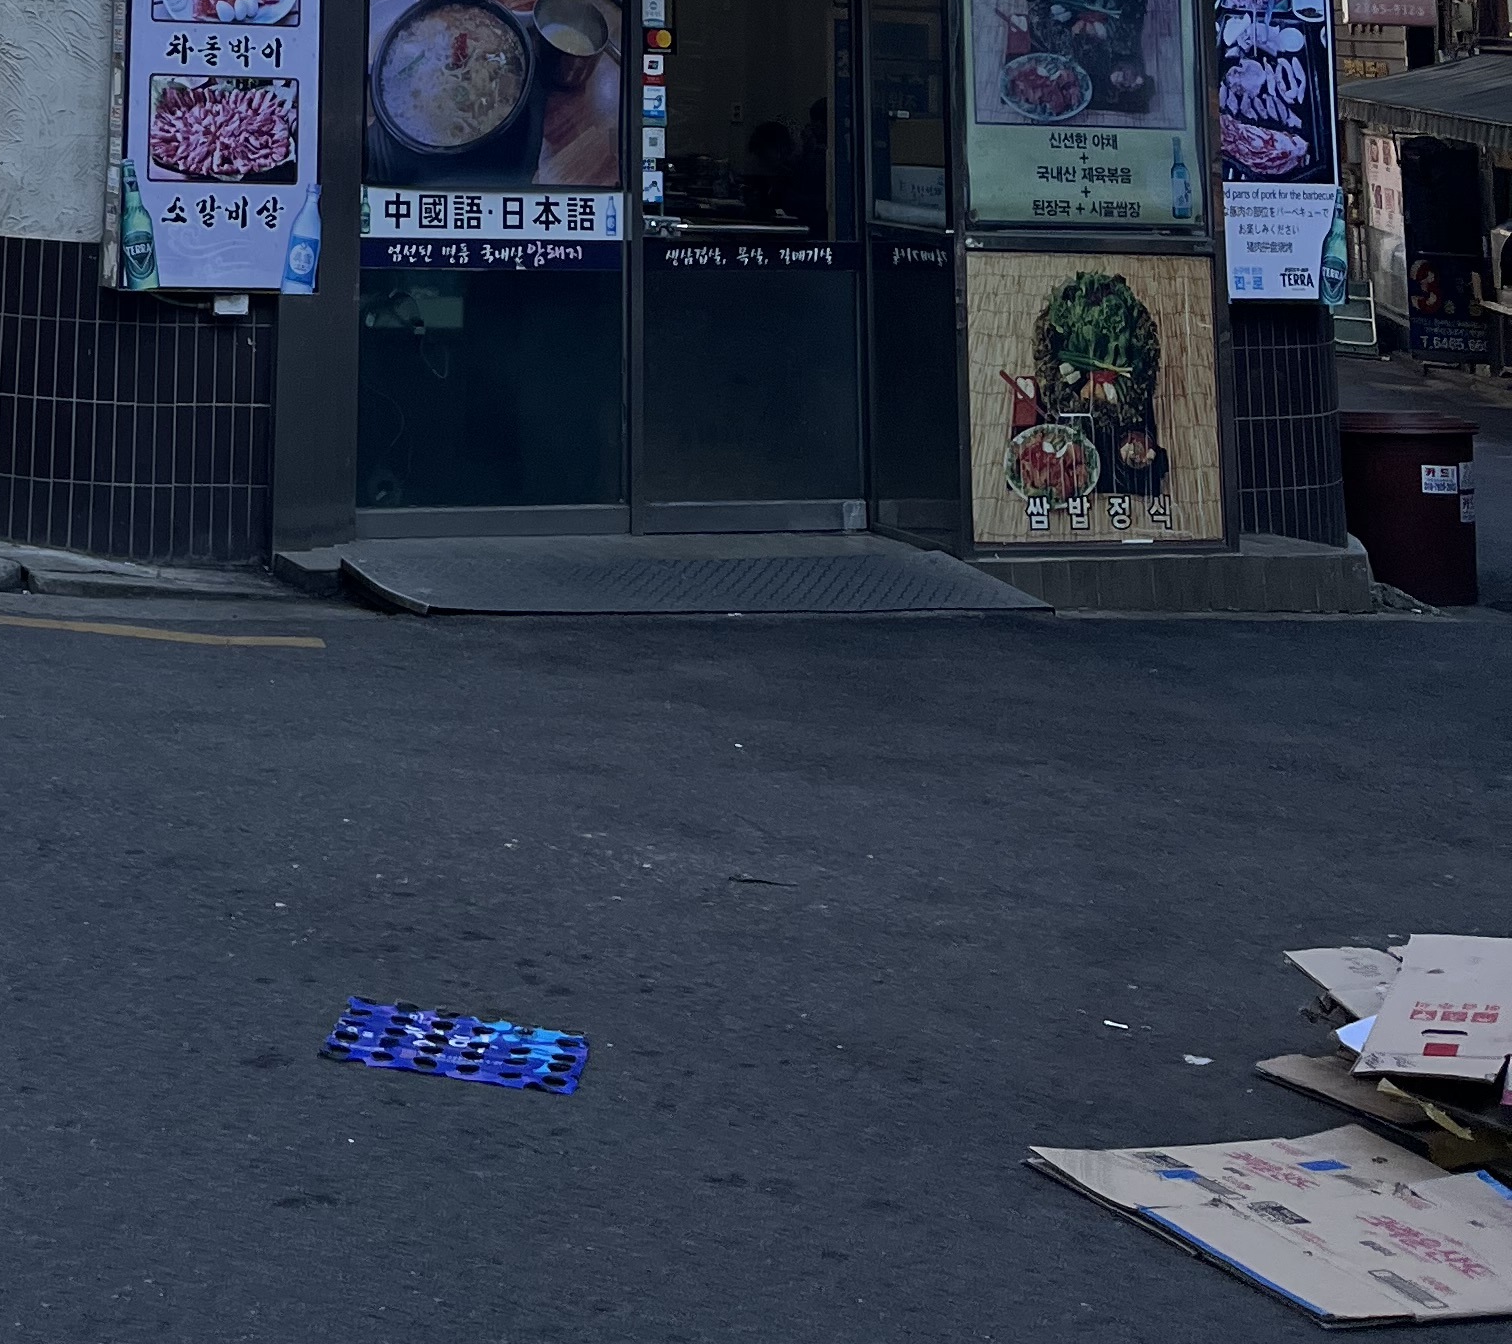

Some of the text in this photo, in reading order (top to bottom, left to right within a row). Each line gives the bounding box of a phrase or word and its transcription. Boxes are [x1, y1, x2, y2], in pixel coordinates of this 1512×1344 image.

[166, 34, 284, 68] 차돌박이
[1048, 131, 1118, 152] 신선한 야채
[1036, 165, 1132, 185] 국내산 제육볶음
[1232, 190, 1250, 201] parts
[1251, 188, 1260, 199] of
[1261, 189, 1277, 201] pork
[1278, 189, 1289, 200] for
[1289, 190, 1301, 200] the
[1302, 190, 1335, 201] barbecue
[161, 194, 285, 229] 소갈비살
[1032, 199, 1071, 217] 된장국
[1090, 200, 1141, 219] 시골쌈장
[125, 242, 152, 257] TERRA
[779, 248, 833, 266] 갈매기살
[1279, 272, 1315, 288] TERRA
[1026, 494, 1174, 531] 쌈밥정식
